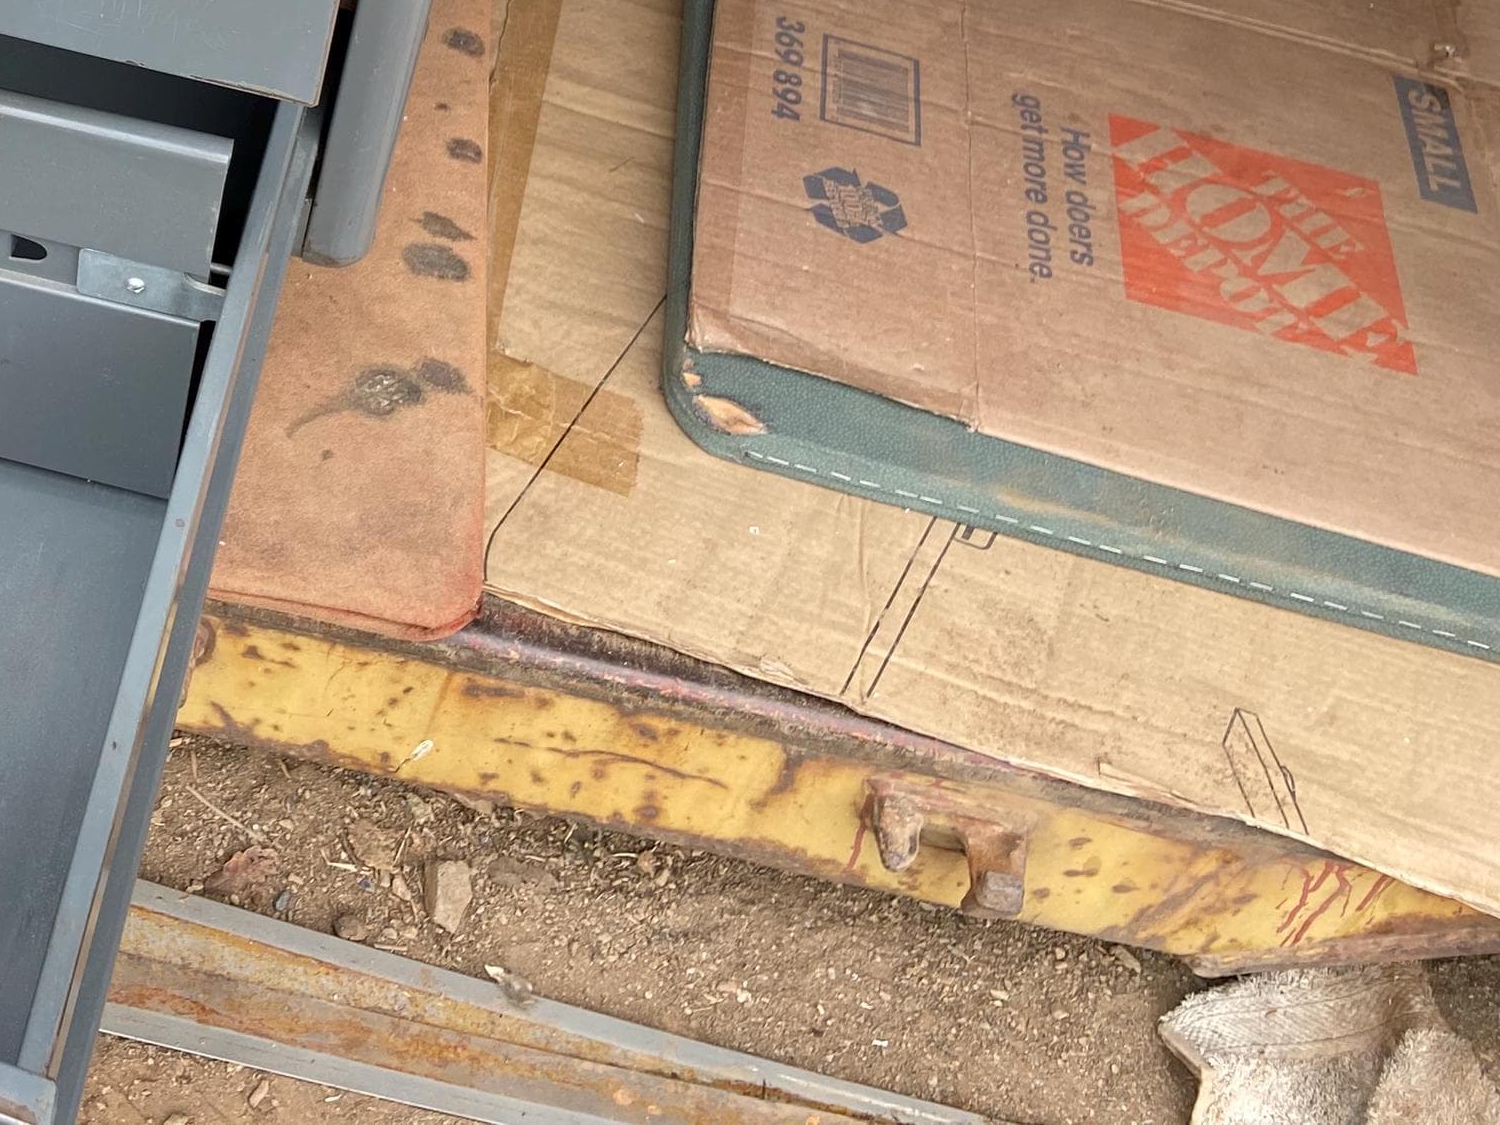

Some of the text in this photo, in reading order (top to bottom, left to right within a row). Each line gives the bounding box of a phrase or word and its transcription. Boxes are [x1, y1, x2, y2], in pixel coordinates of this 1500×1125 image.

[771, 16, 805, 121] 369 894
[1012, 91, 1058, 283] get more done.
[1060, 126, 1097, 267] How doers
[1408, 88, 1461, 192] SMALL
[1111, 125, 1412, 365] HOME
[1117, 191, 1305, 337] DEPOT
[1252, 171, 1365, 259] THE
